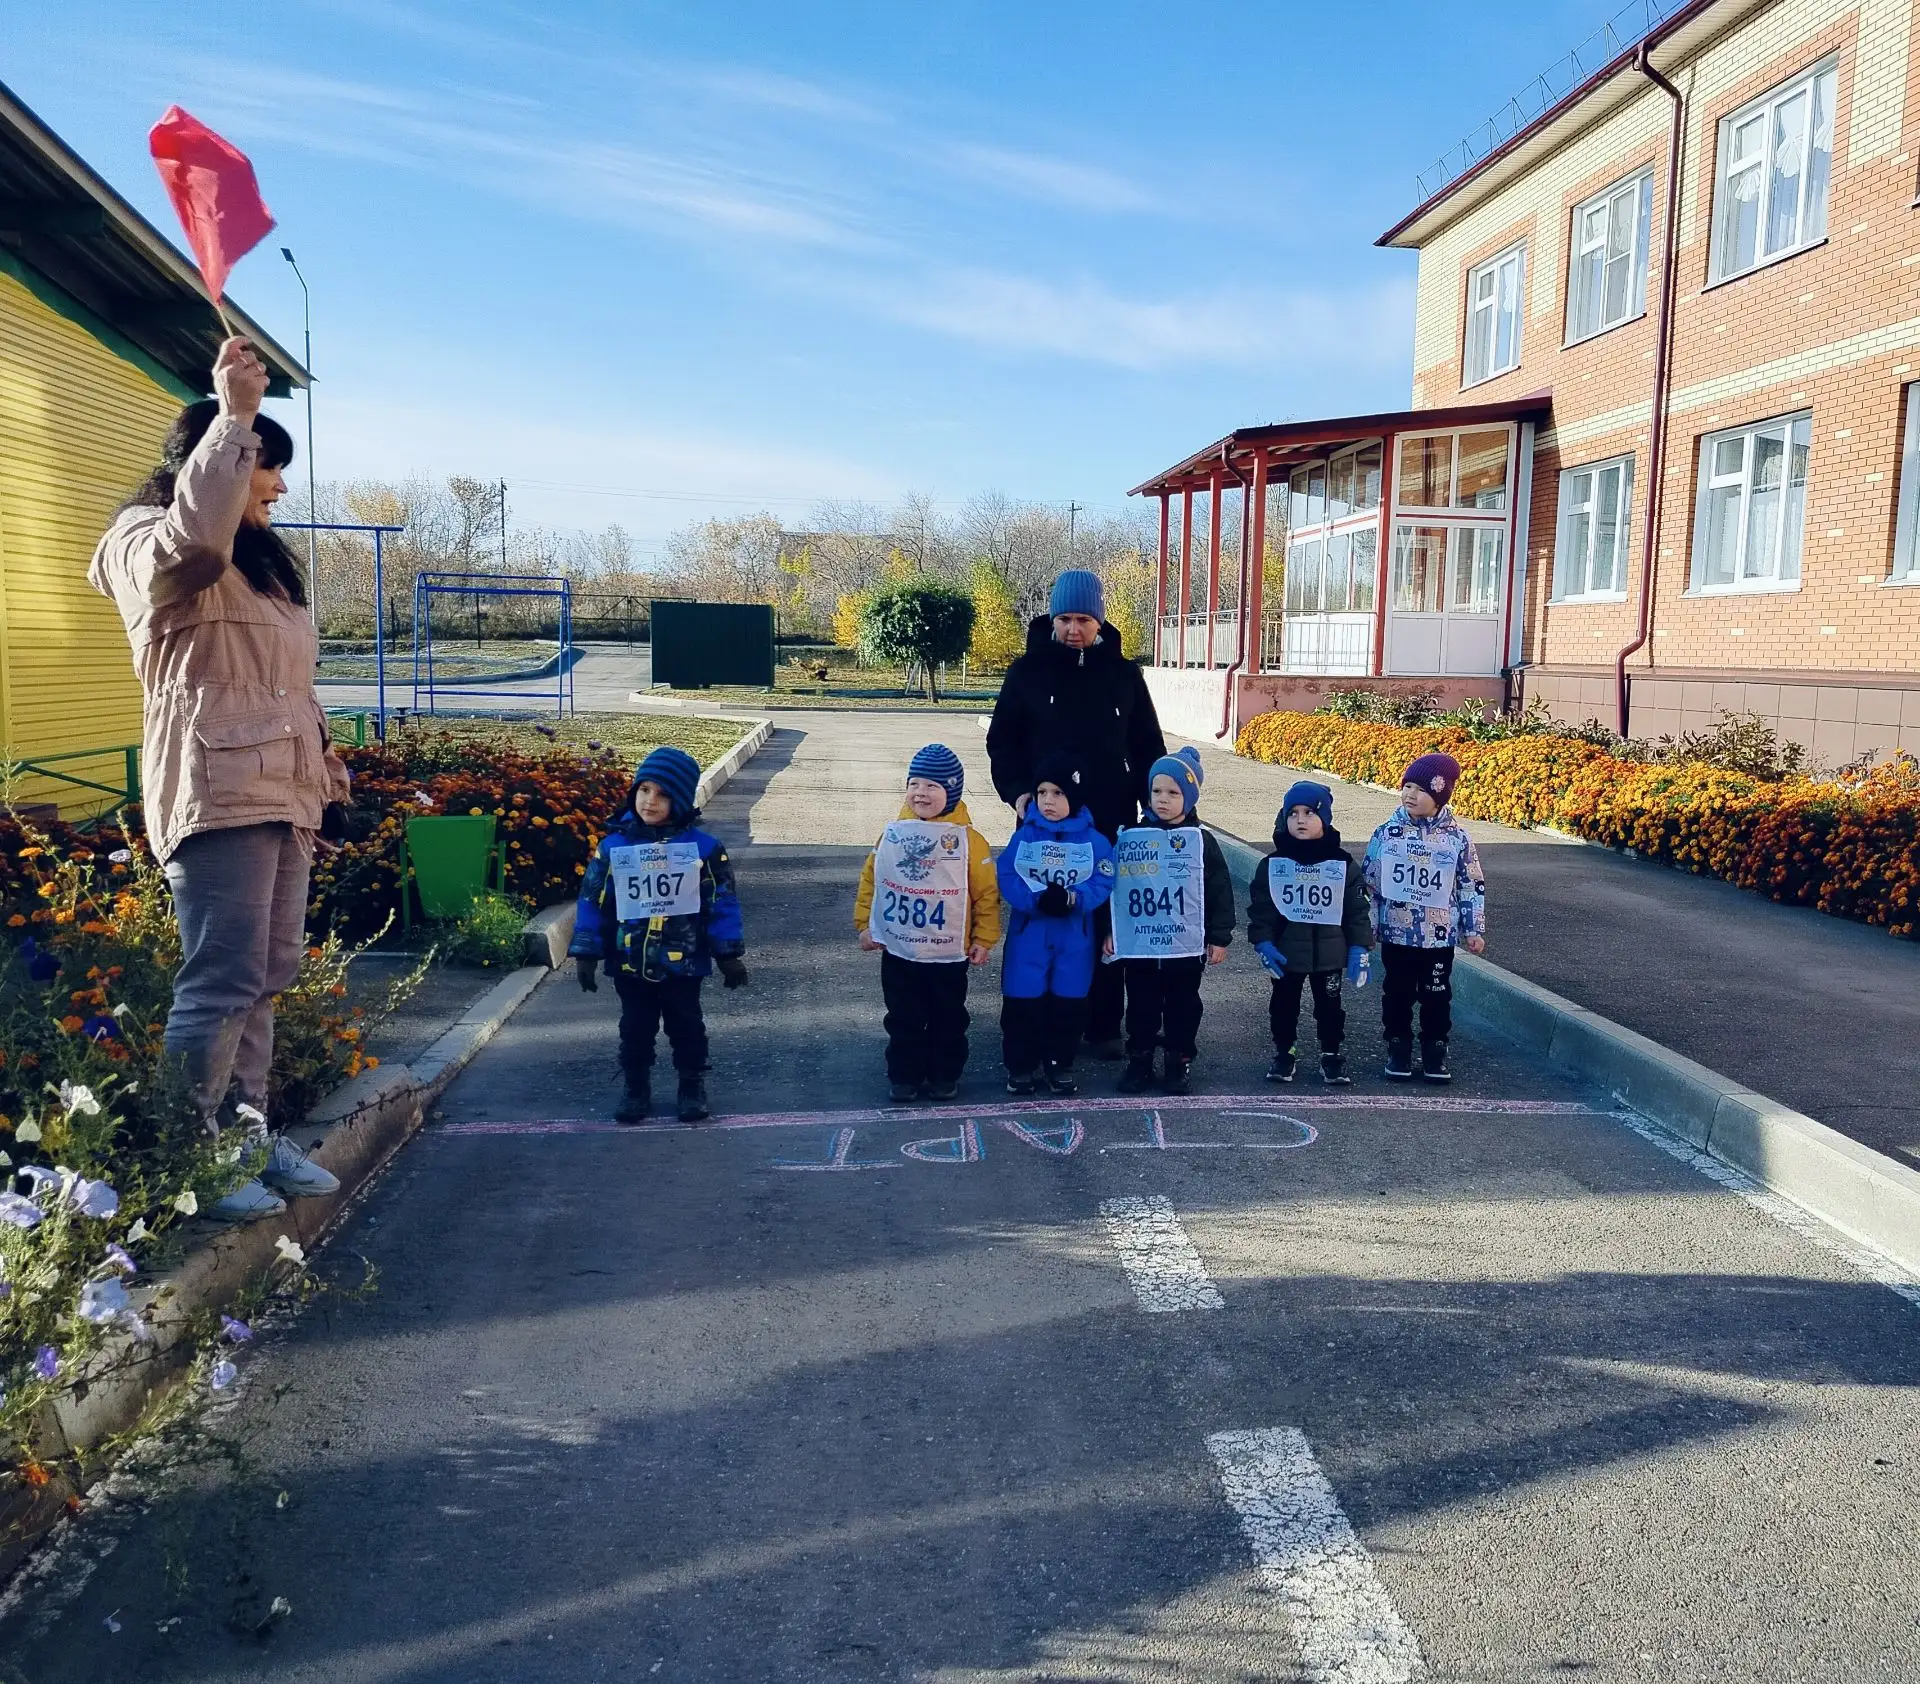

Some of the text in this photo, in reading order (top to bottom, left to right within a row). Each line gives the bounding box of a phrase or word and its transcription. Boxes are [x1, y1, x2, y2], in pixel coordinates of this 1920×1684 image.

[1117, 851, 1159, 863] НАЦИИ
[1406, 848, 1432, 857] НАЦИИ
[640, 854, 668, 863] НАЦИИ
[1119, 863, 1160, 876] 2020
[1295, 866, 1321, 874] НАЦИИ
[1392, 863, 1442, 890] 5184
[628, 872, 684, 900] 5167
[904, 886, 935, 895] РОССИИ
[1282, 884, 1333, 907] 5169
[1402, 887, 1432, 897] АЛТАЙСКИЙ
[641, 900, 675, 908] АЛТАЙСКИЙ
[1128, 886, 1184, 918] 8841
[883, 890, 946, 930] 2584
[1292, 907, 1323, 915] АЛТАЙСКИЙ
[1134, 923, 1187, 935] АЛТАЙСКИЙ
[930, 937, 954, 945] край
[1149, 935, 1173, 946] КРАЙ
[771, 1110, 1318, 1171] СТАРТ
